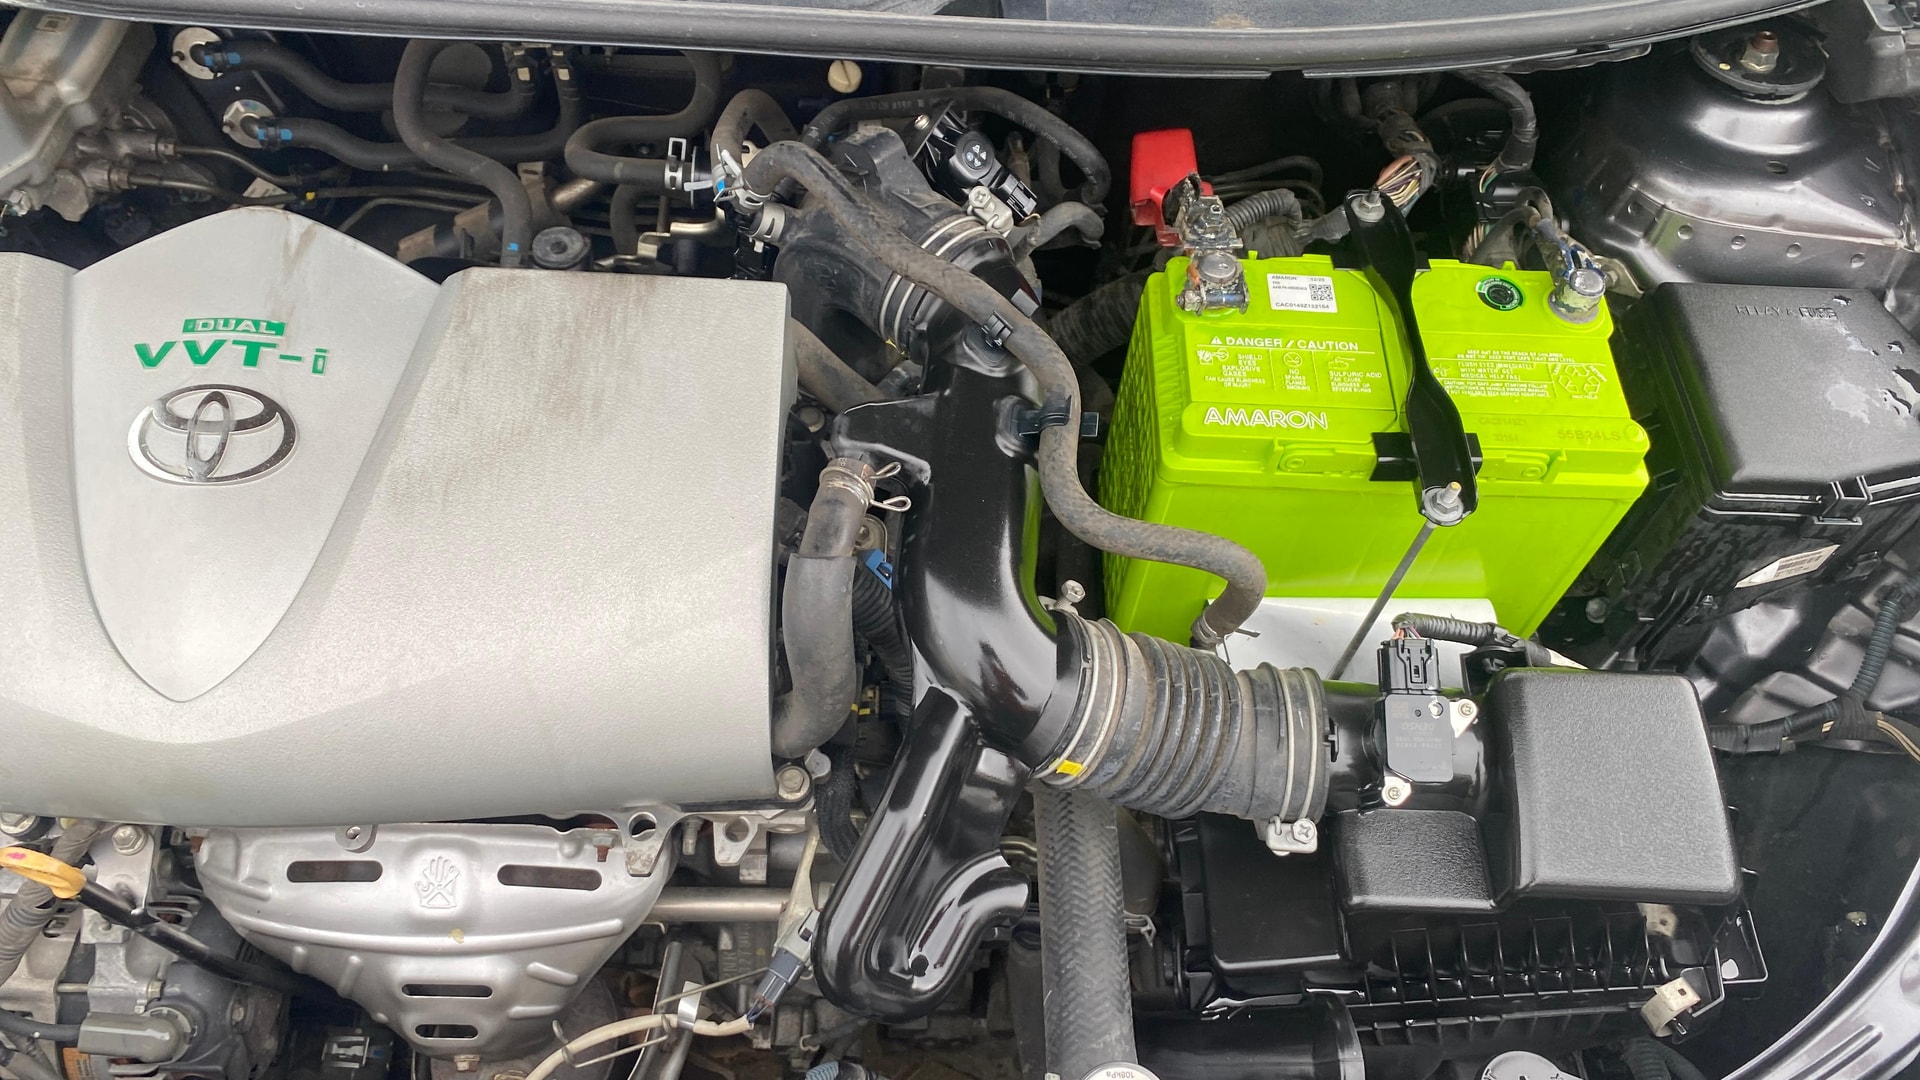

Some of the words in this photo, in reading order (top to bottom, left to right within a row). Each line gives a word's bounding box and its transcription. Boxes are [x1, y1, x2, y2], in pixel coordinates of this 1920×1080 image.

[1735, 305, 1781, 316] RELAY
[1799, 306, 1838, 320] FUSE
[194, 318, 276, 334] DUAL
[1225, 336, 1282, 347] DANGER
[1297, 339, 1359, 351] CAUTION
[134, 339, 329, 375] VVT-i
[1203, 406, 1329, 430] AMARON
